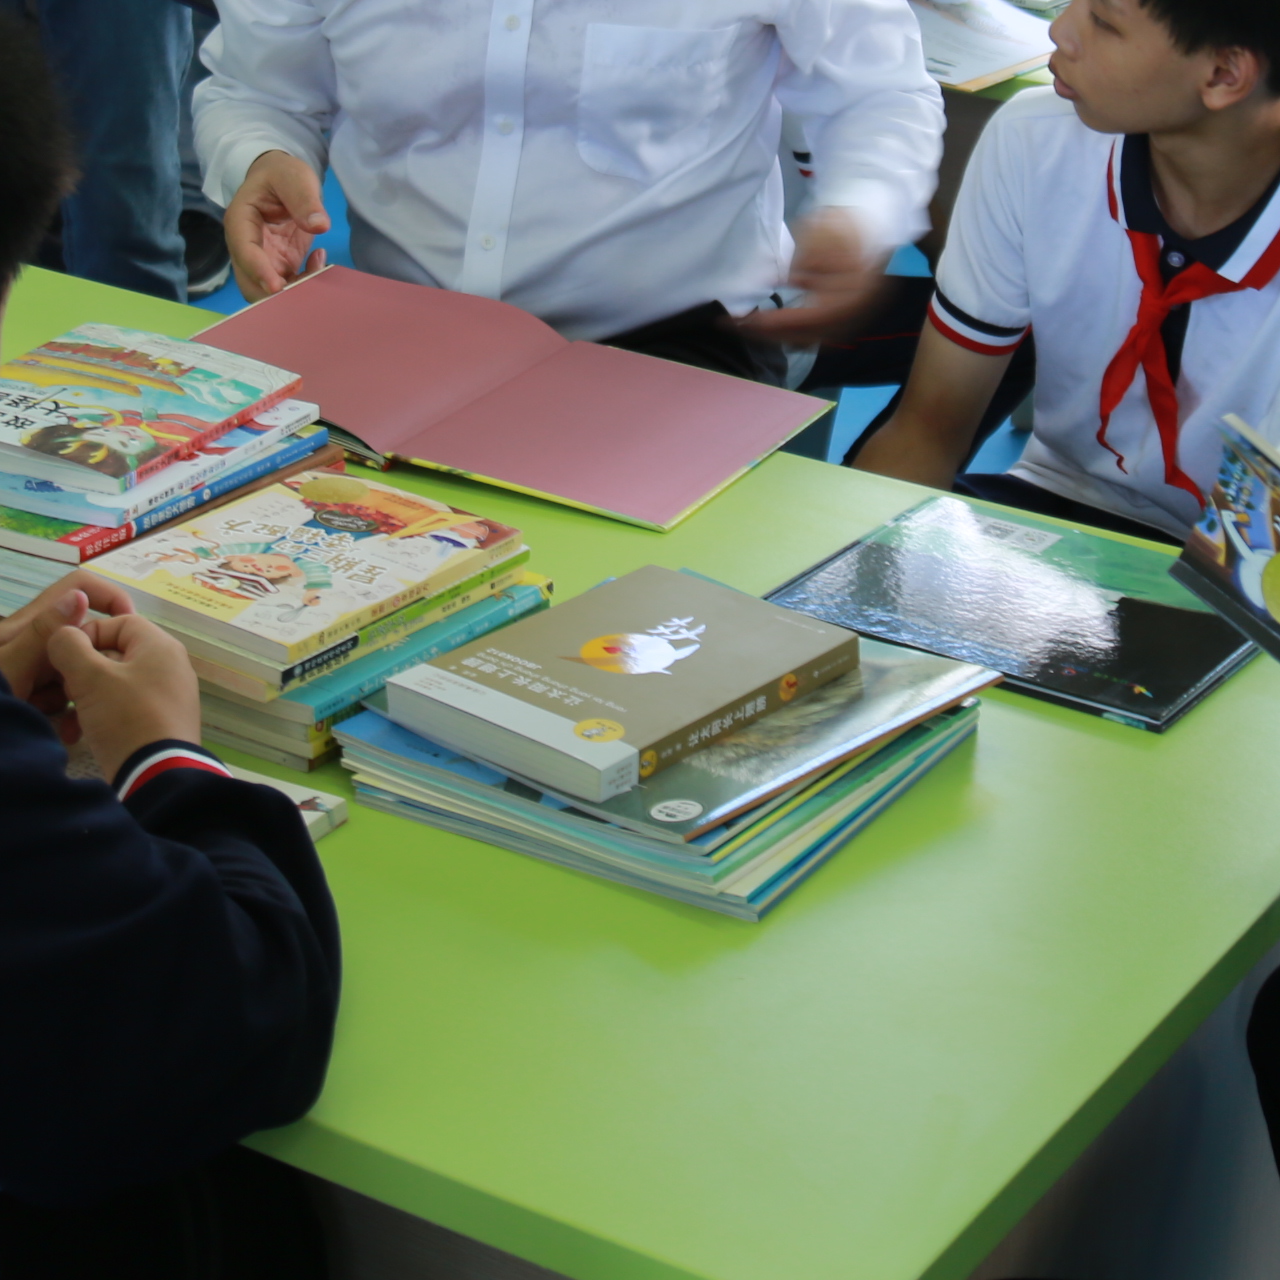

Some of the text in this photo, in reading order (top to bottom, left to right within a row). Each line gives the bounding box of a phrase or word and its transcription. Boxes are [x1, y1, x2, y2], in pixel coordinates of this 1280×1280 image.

[219, 519, 353, 553] 幸福配方
[273, 541, 387, 583] 星期三的
[460, 656, 585, 707] 让太阳长上翅膀
[687, 694, 768, 748] 让太阳长上翅膀
